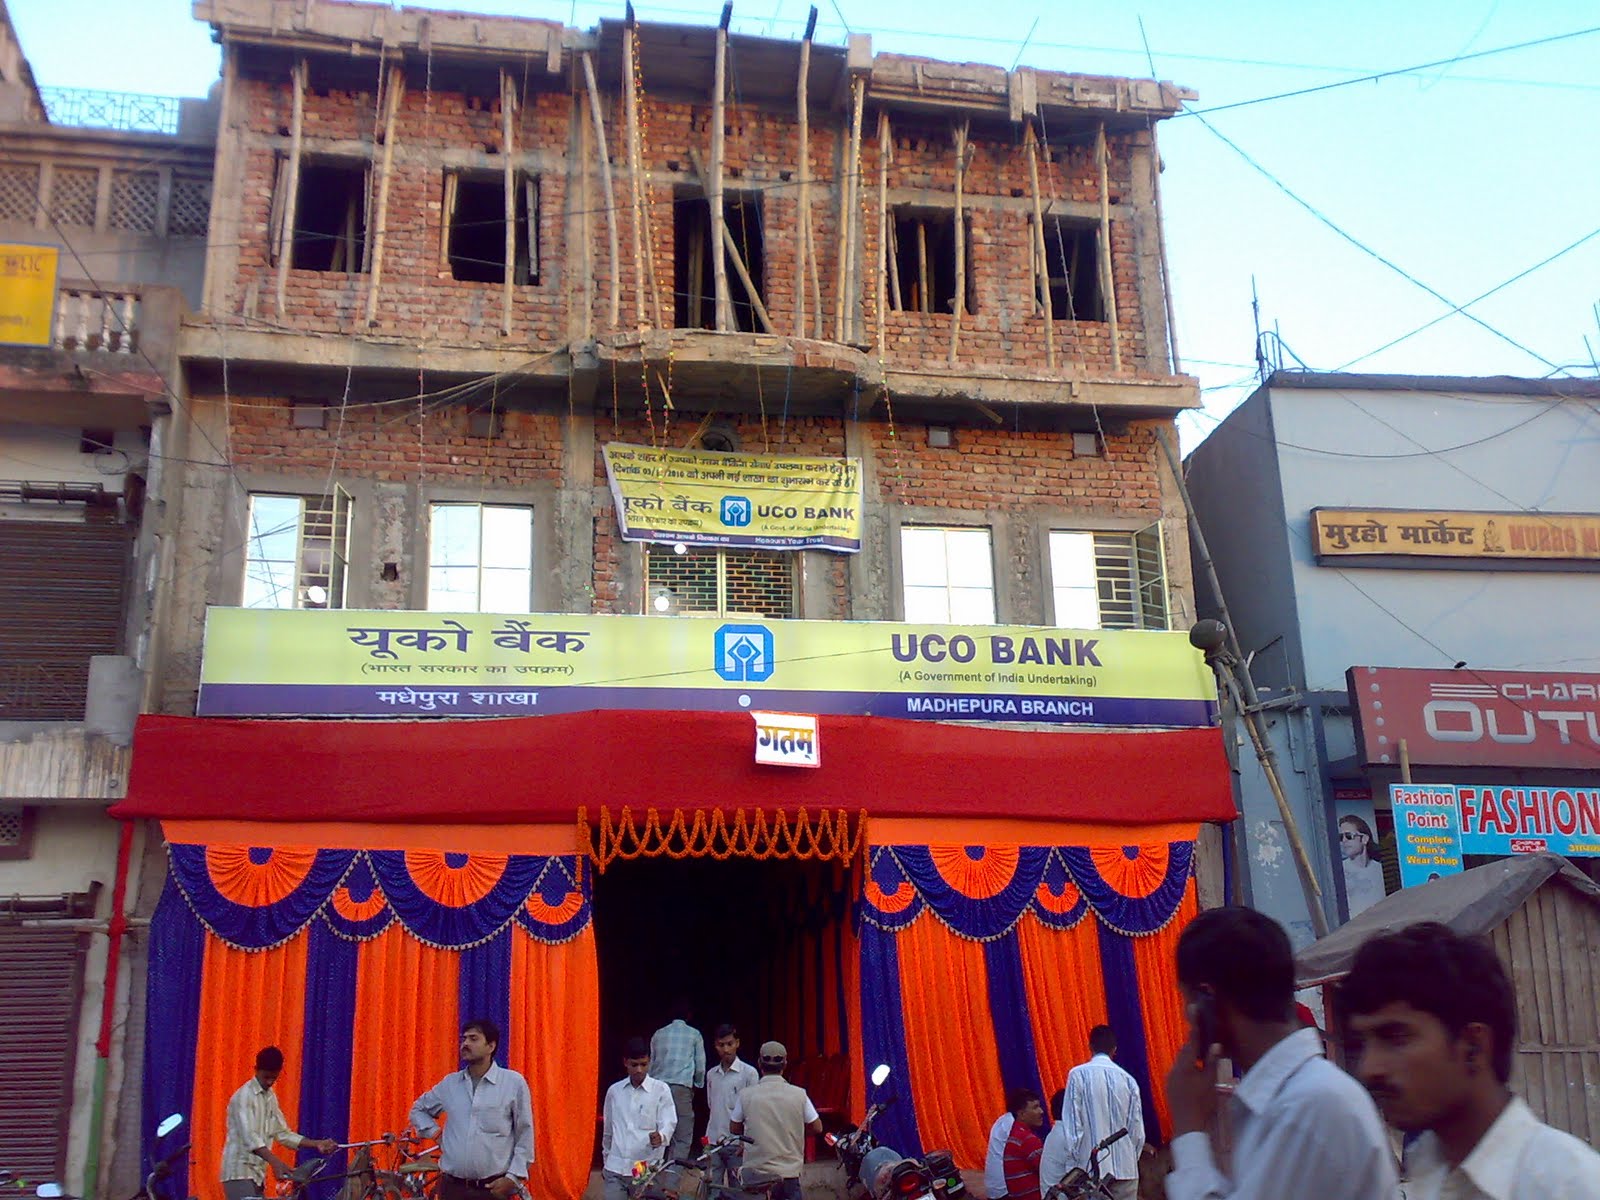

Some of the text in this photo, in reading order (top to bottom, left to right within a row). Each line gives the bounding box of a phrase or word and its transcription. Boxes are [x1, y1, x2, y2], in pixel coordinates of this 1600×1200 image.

[669, 495, 713, 514] बैंक
[757, 505, 855, 520] UCO BANK
[1322, 519, 1474, 549] मुरहो मार्केट
[346, 619, 591, 660] यूको बैंक
[891, 633, 1102, 667] UCO BANK
[361, 662, 575, 676] (भारत सरकार का उपक्रम)
[899, 669, 1097, 688] (A Government of India Undertaking)
[376, 687, 539, 710] मधेपुरा शाखा
[1501, 683, 1600, 700] CHAR
[907, 697, 1094, 716] MADHEPURA BRANCH
[1395, 789, 1453, 806] Fashion
[1407, 812, 1447, 828] Point
[1459, 789, 1600, 835] FASHION
[1407, 834, 1453, 844] Complete
[1417, 845, 1446, 854] Men's
[1407, 855, 1459, 866] Wear Shop
